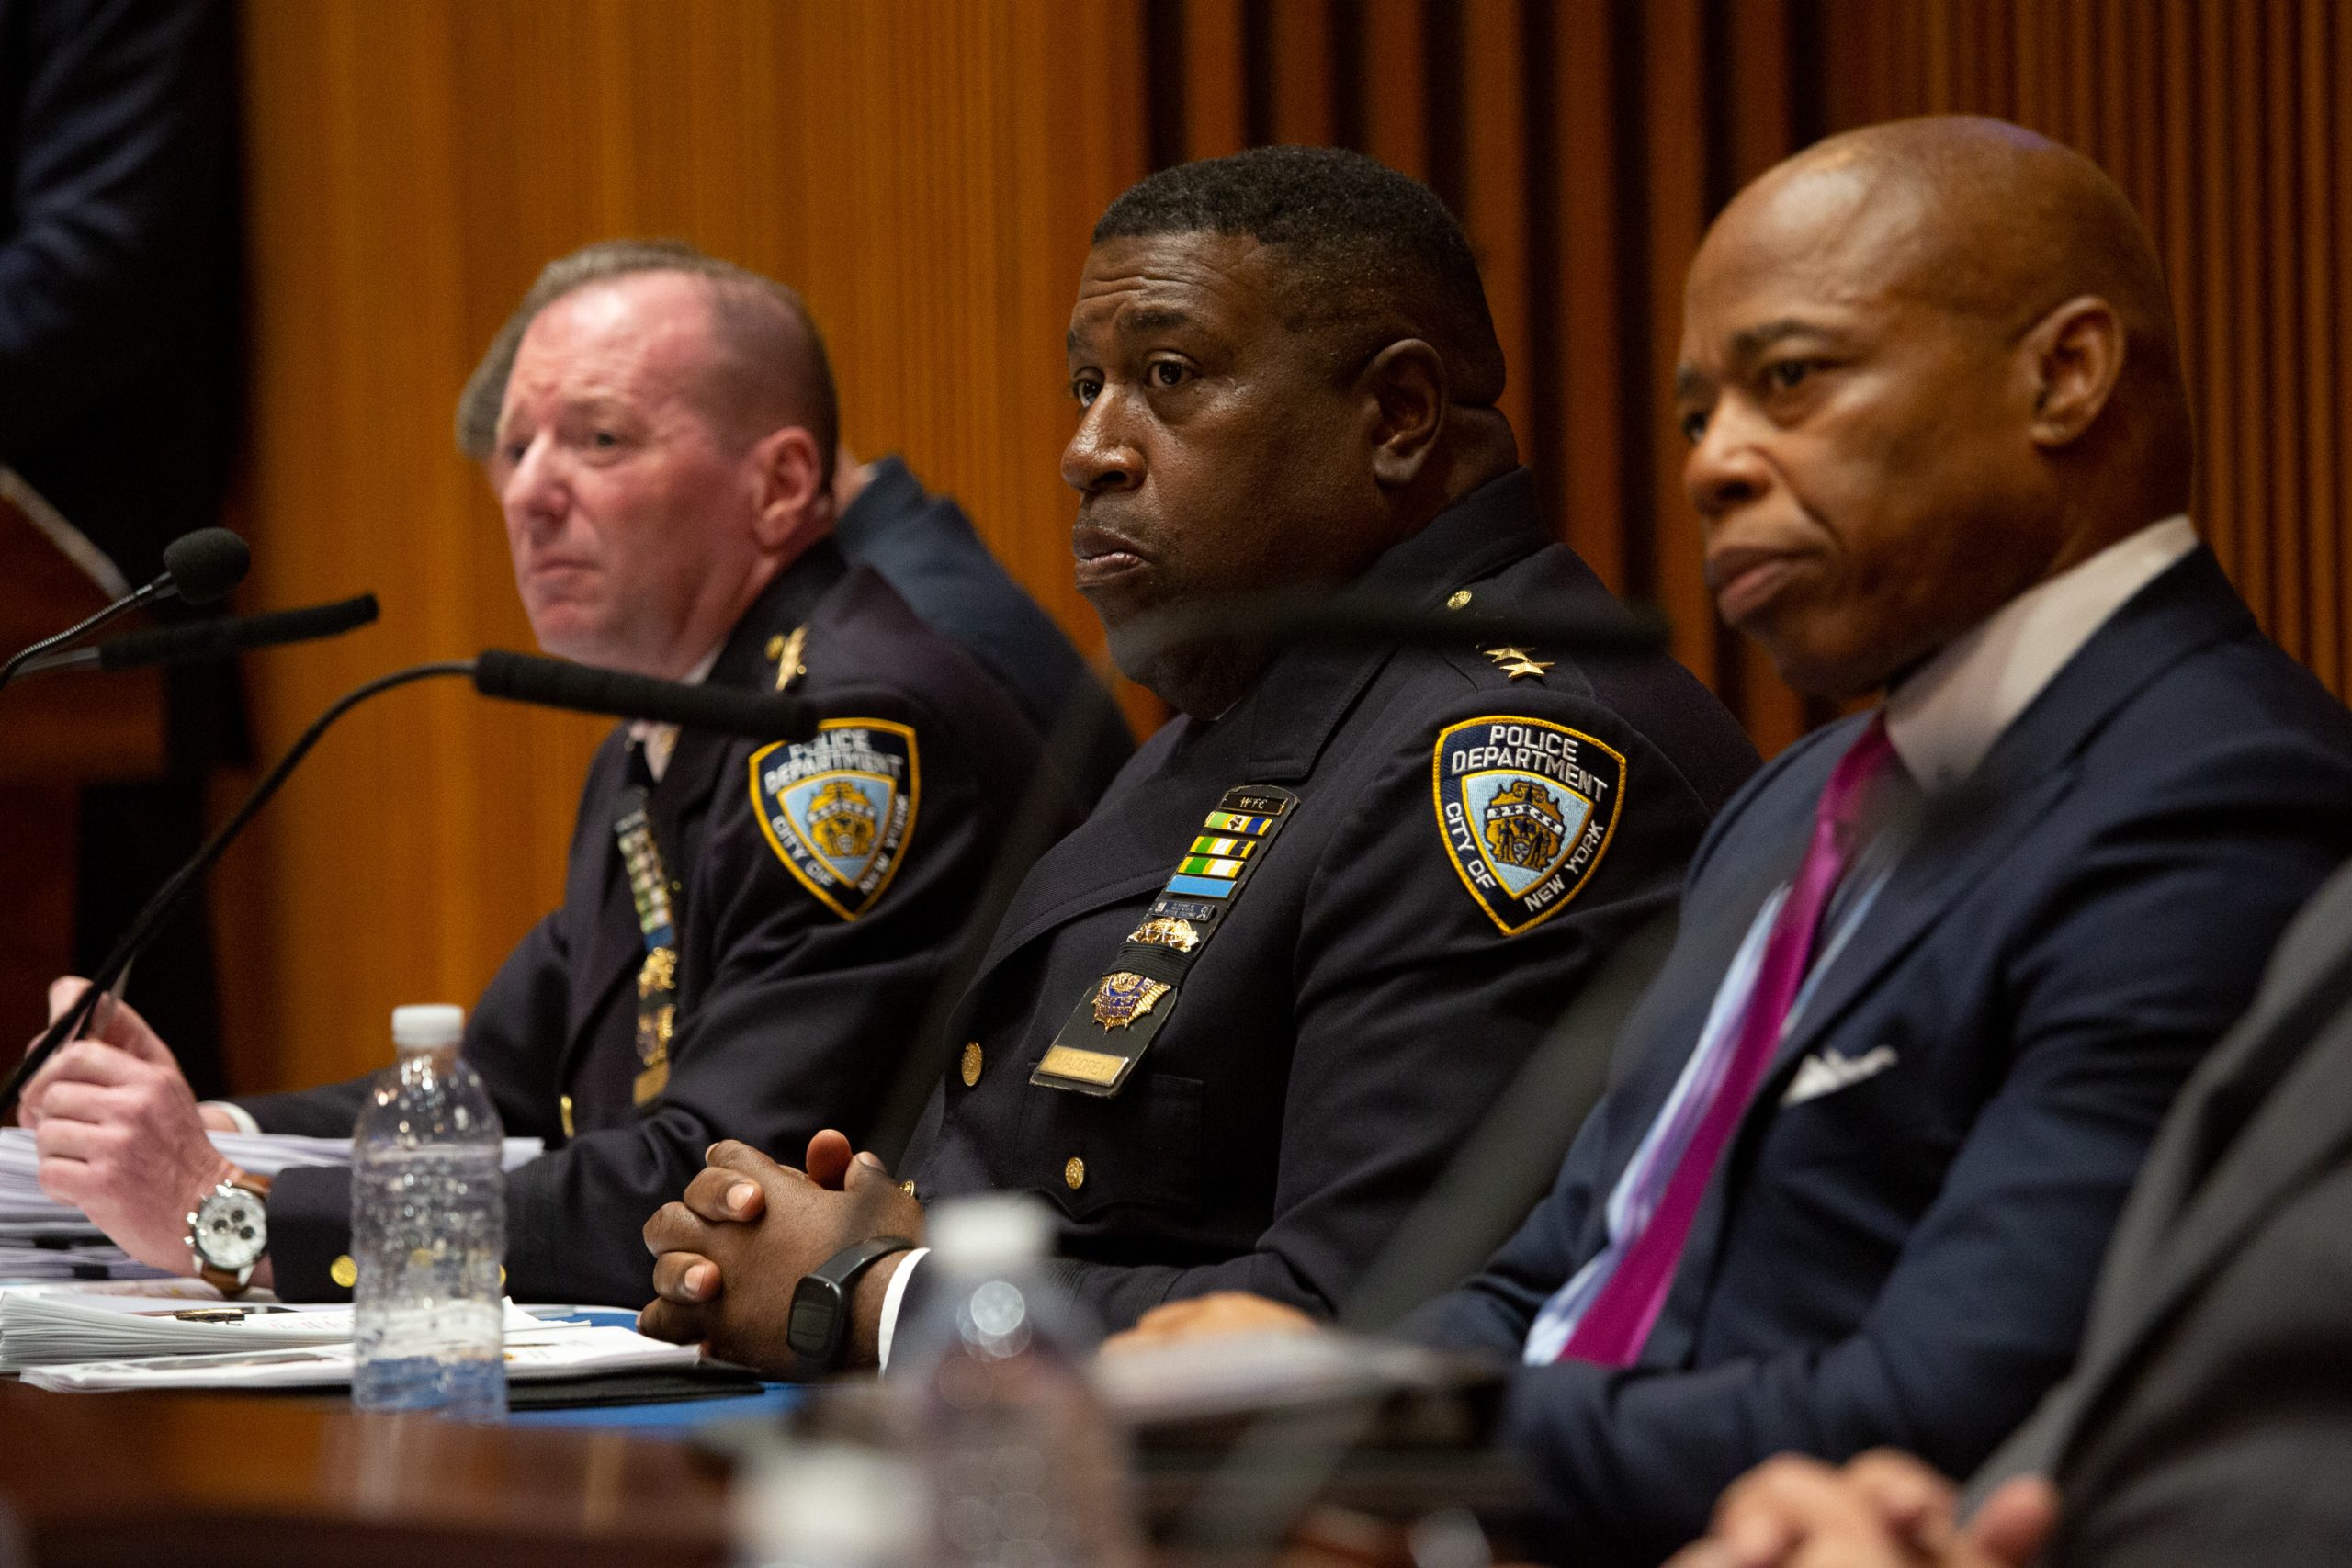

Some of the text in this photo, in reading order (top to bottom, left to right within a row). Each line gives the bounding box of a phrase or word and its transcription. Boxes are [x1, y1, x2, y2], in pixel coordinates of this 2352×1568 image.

[1452, 746, 1608, 802] DEPARTMENT
[1489, 725, 1578, 763] POLICE
[1445, 802, 1497, 889] CITY OF
[1524, 819, 1604, 912] NEW YORK
